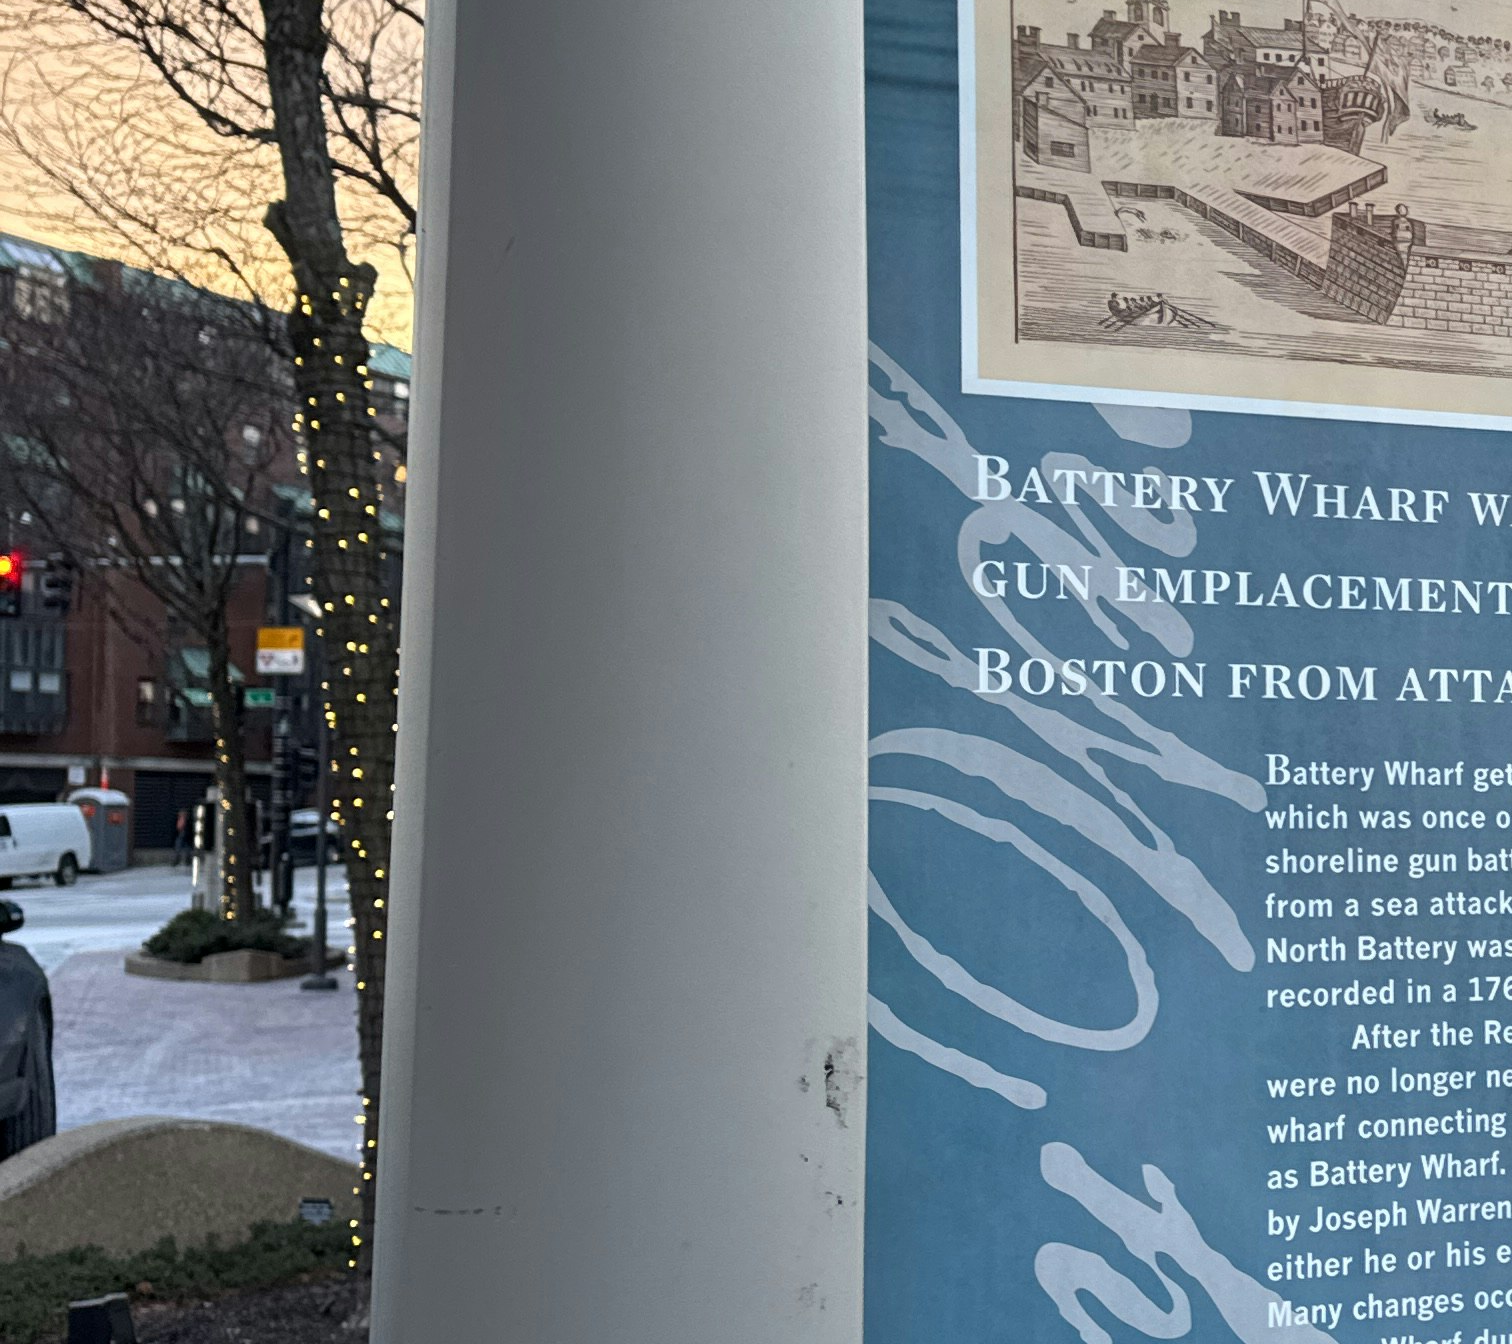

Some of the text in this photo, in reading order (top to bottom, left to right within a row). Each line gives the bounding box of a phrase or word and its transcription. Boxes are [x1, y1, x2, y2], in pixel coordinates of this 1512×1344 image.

[972, 451, 1236, 513] BATTERY
[1253, 471, 1449, 524] WHARF
[972, 559, 1093, 600] GUN
[972, 646, 1206, 698] BOSTON
[1228, 664, 1378, 700] FROM
[1264, 753, 1375, 793] Battery
[1383, 760, 1465, 787] Wharf
[1264, 799, 1348, 830] which
[1358, 809, 1412, 830] was
[1421, 809, 1487, 830] once
[1265, 846, 1399, 875] shoreline
[1407, 853, 1457, 880] gun
[1264, 892, 1333, 919] from
[1343, 897, 1360, 918] a
[1370, 896, 1419, 917] sea
[1266, 935, 1347, 964] North
[1357, 934, 1458, 966] Battery
[1266, 978, 1395, 1009] recorded
[1406, 977, 1432, 1004] in
[1441, 983, 1457, 1003] a
